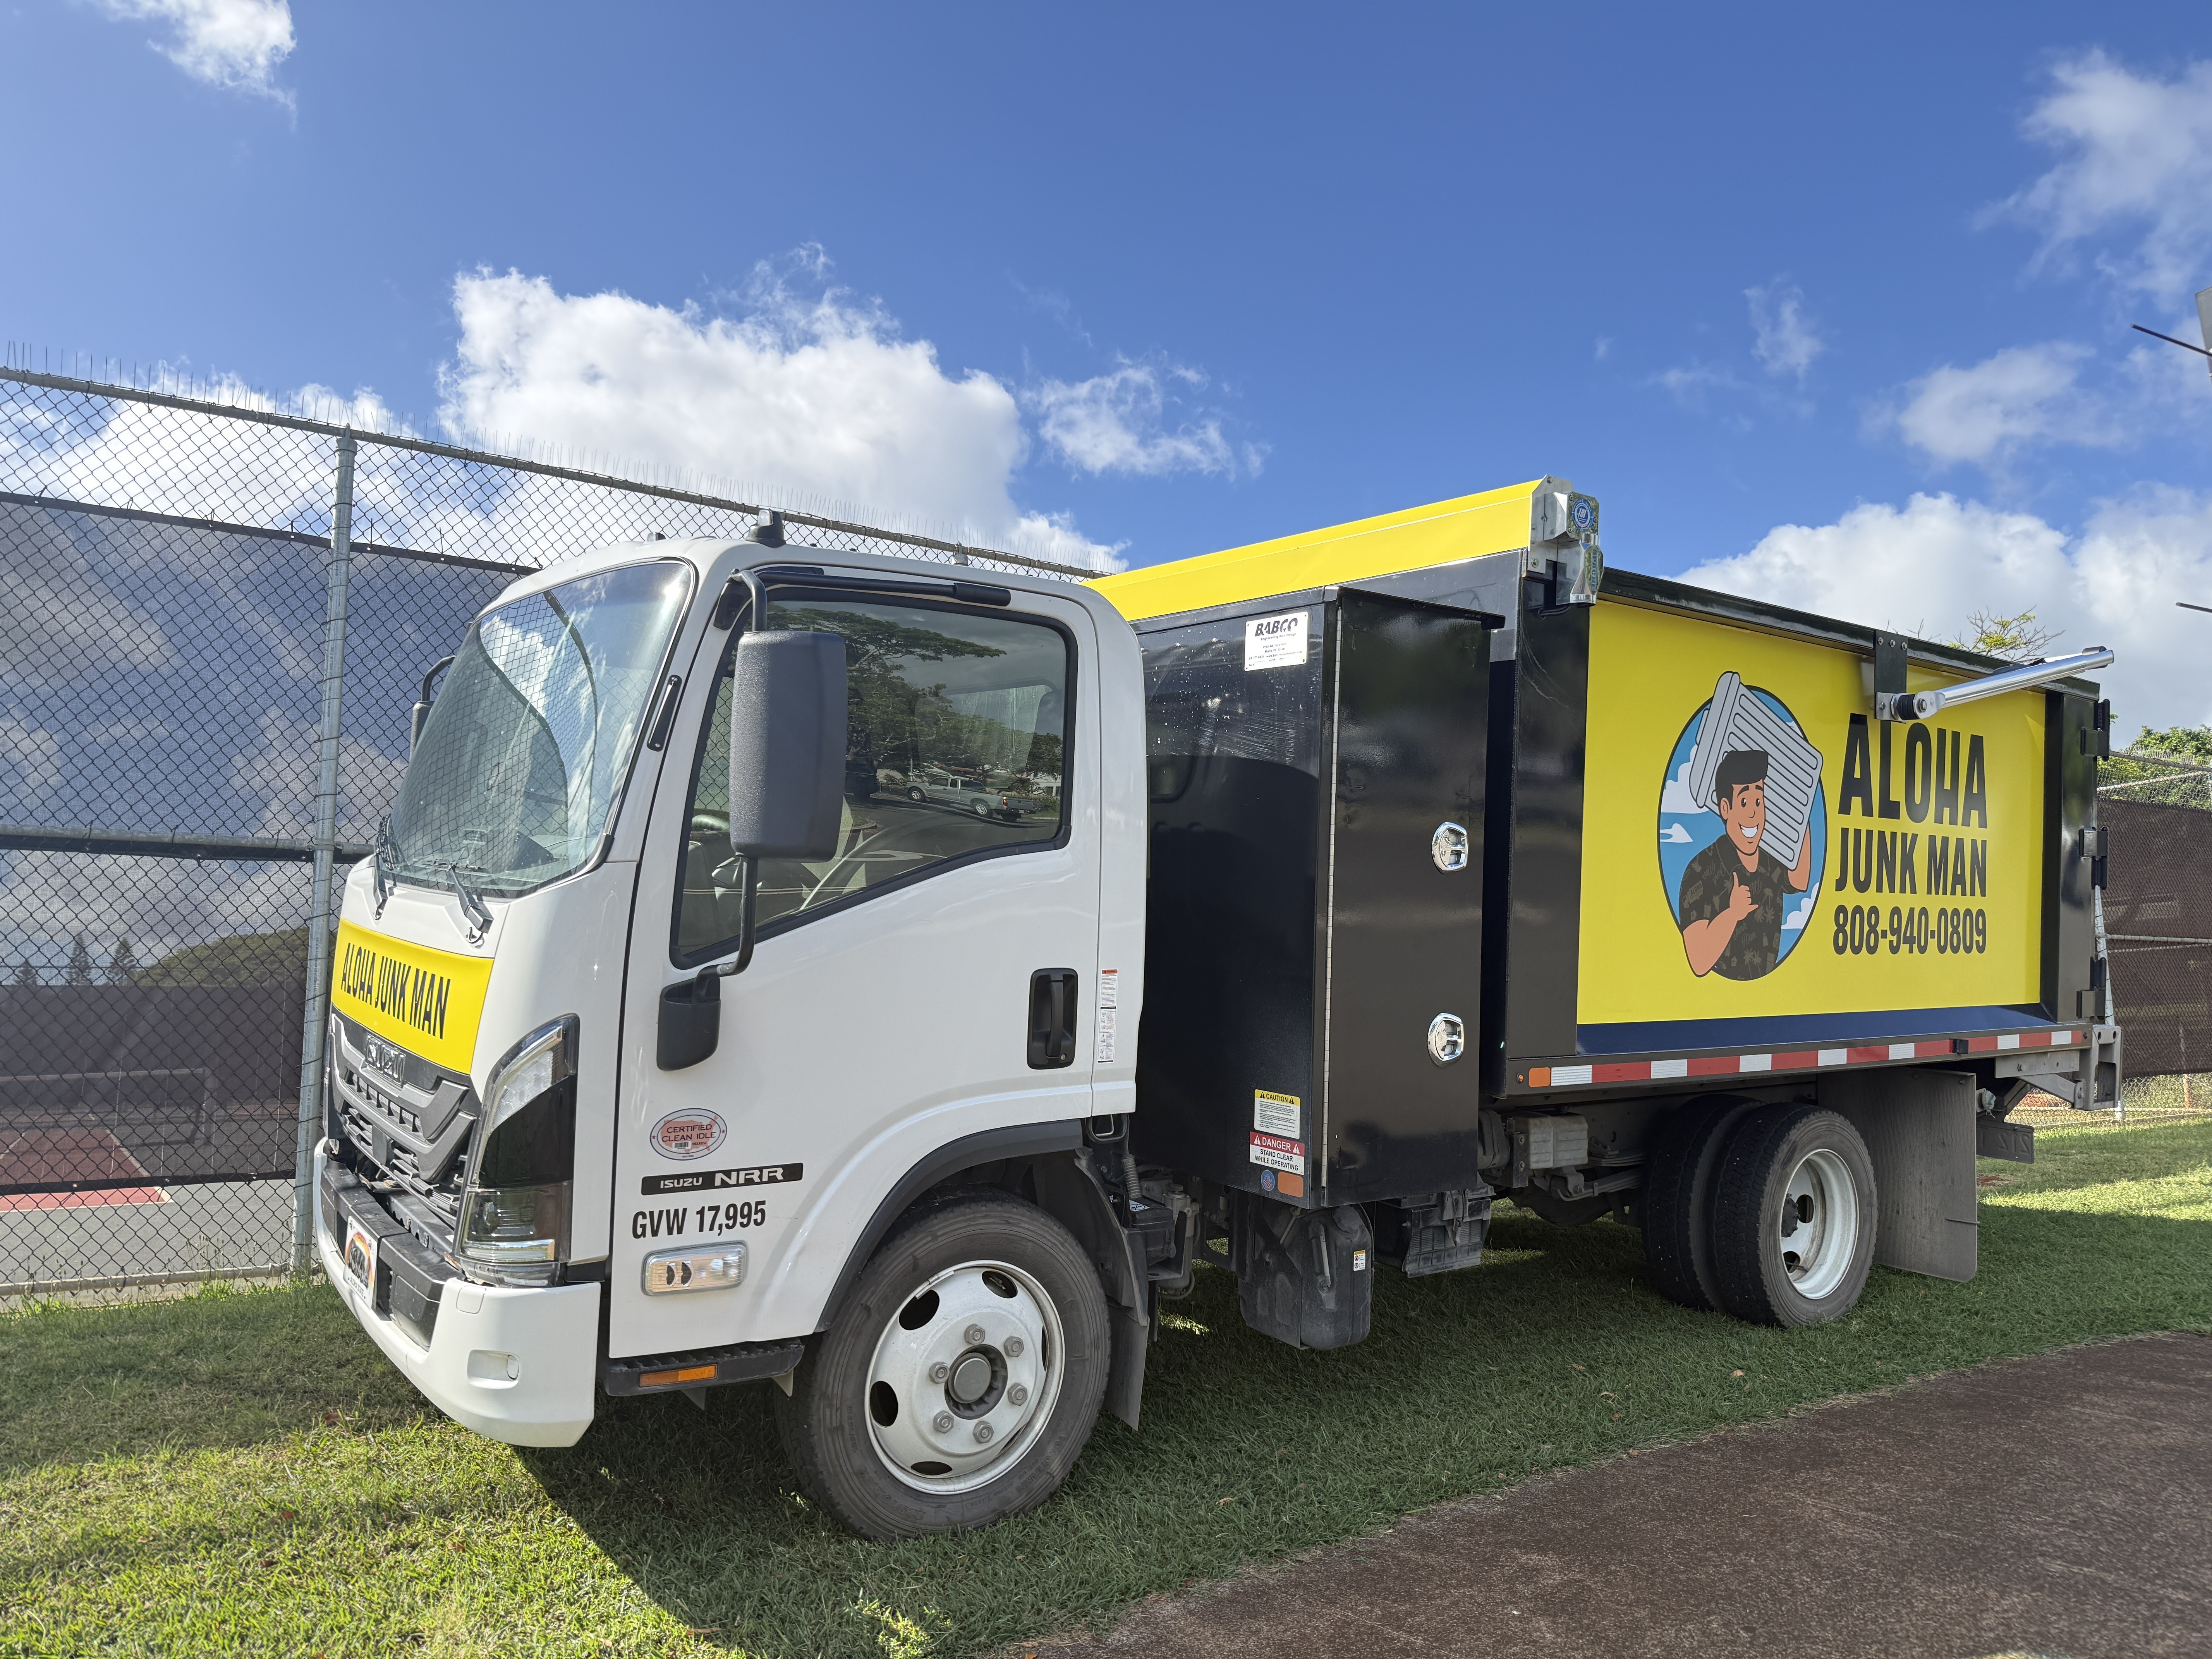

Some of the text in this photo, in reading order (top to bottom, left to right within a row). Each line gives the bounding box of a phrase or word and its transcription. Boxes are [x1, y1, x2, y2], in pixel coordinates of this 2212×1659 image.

[1838, 713, 1987, 829] ALOHA
[1835, 827, 1987, 897] JUNK MAN
[1833, 904, 1987, 955] 808-940-0809
[341, 943, 451, 1039] ALOHA JUNK MAN
[1266, 1093, 1288, 1103] CAUTION
[667, 1124, 712, 1133] CERTIFIED
[1260, 1149, 1293, 1162] STAND CLEAR
[1262, 1137, 1291, 1151] DANGER
[660, 1167, 784, 1188] ISUZU NRR
[1255, 1155, 1298, 1171] WHILE OPERATING
[632, 1200, 766, 1239] GVW 17,995
[1016, 1436, 1066, 1492] YOKOHAMA
